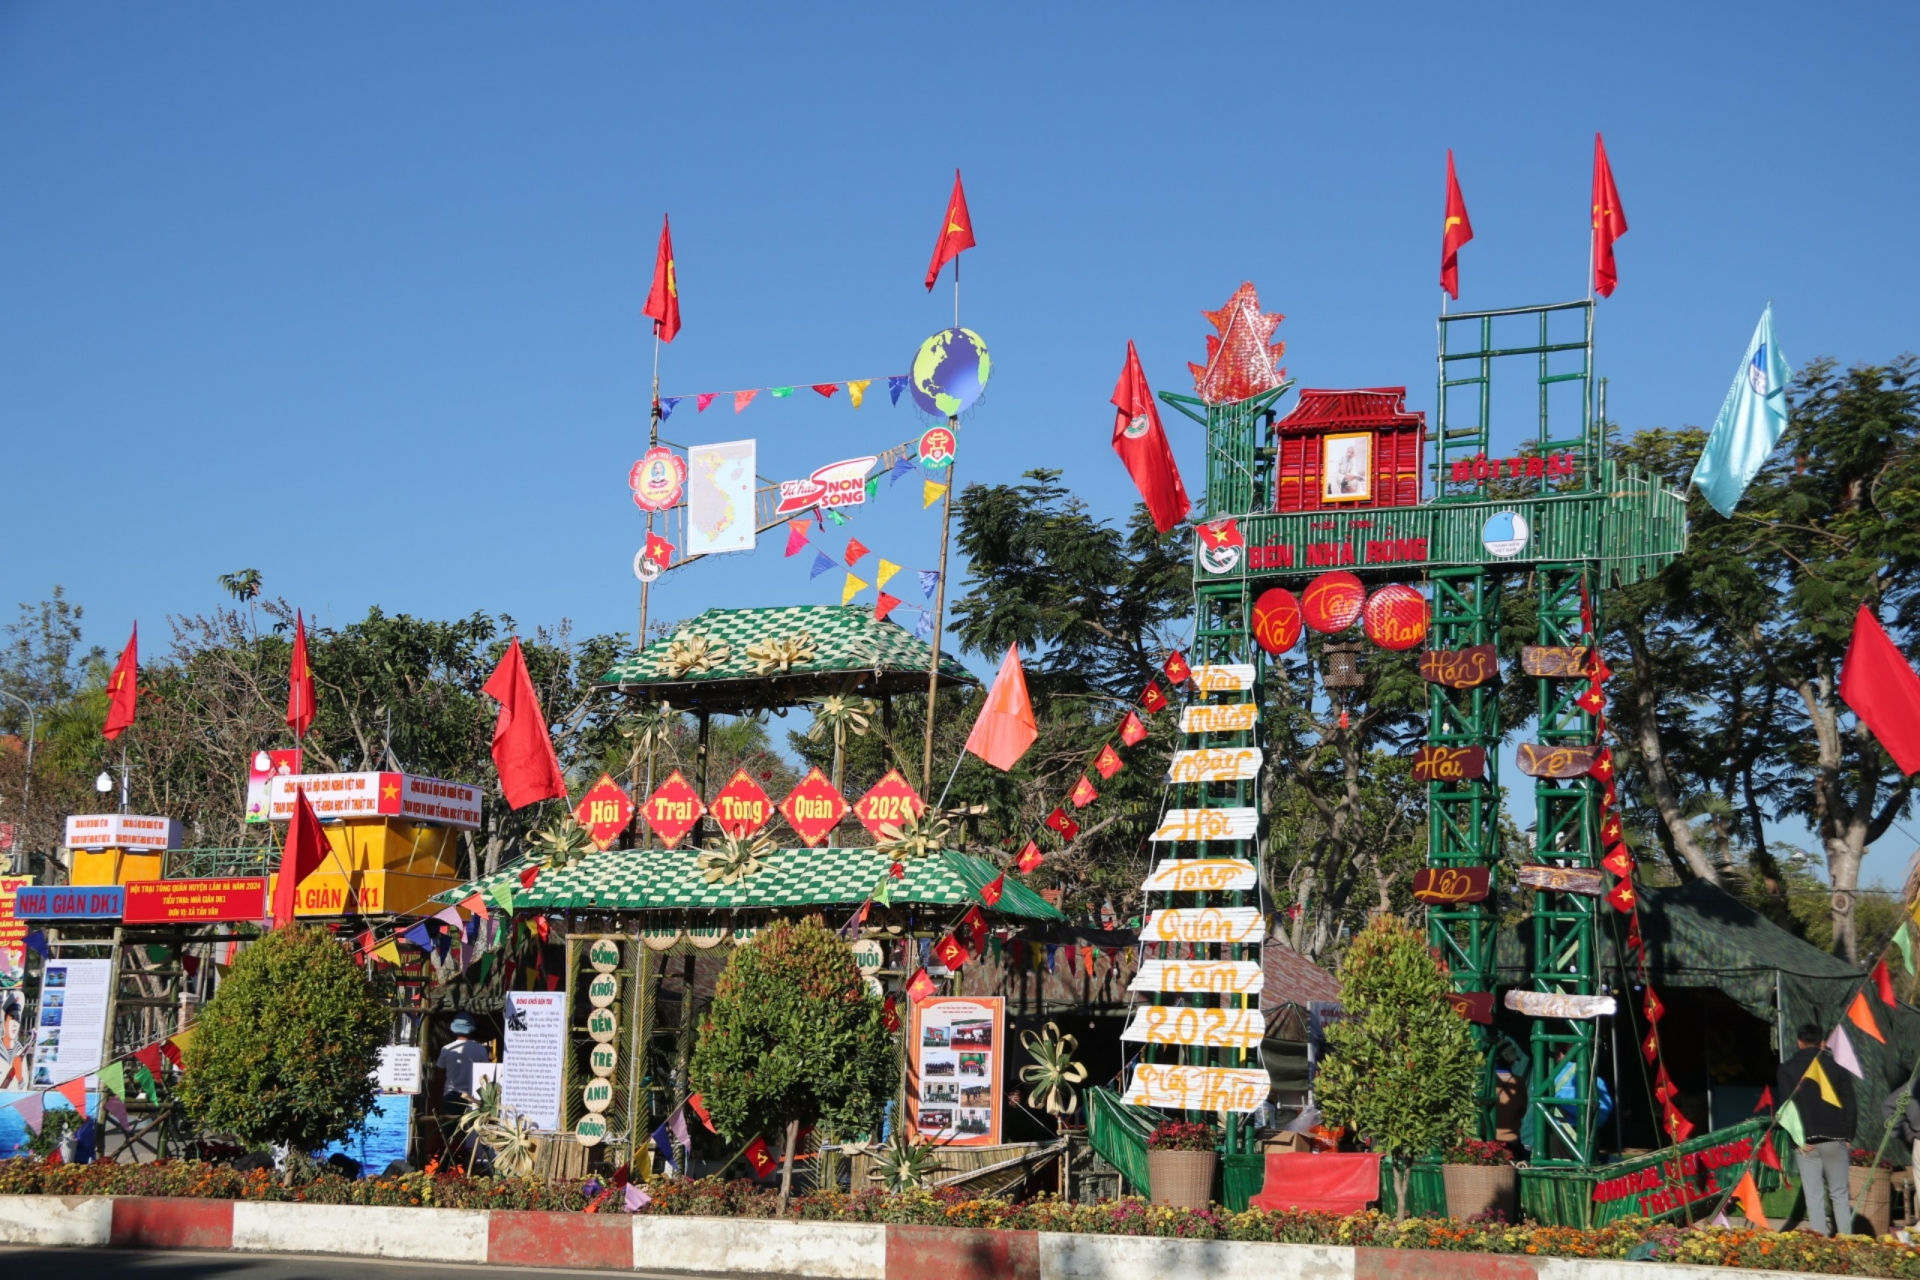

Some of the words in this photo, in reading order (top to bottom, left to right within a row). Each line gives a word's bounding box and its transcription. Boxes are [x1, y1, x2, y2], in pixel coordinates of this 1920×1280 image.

[1452, 451, 1501, 486] HỘI
[1507, 454, 1574, 481] TRẠI
[828, 478, 863, 491] NON
[821, 491, 864, 507] SÔNG
[1249, 533, 1294, 569] BẾN
[1306, 534, 1355, 566] NHÀ
[1366, 525, 1428, 563] RỒNG
[1254, 607, 1297, 648] Xã
[1305, 582, 1360, 620] Tân
[590, 800, 619, 828] Hội
[655, 797, 692, 825] Trại
[722, 796, 762, 824] Tòng
[795, 794, 833, 819] Quân
[869, 796, 911, 820] 2024
[209, 880, 221, 891] LÂM
[223, 880, 231, 891] HÀ
[232, 880, 245, 890] NĂM
[245, 882, 261, 890] 2024
[306, 883, 342, 908] GIÀN
[350, 887, 379, 908] DK1
[20, 889, 47, 914] NHÀ
[53, 889, 86, 914] GIÀN
[90, 894, 119, 914] DK1
[591, 1010, 612, 1033] BẾN
[1146, 1005, 1265, 1048] 2024
[593, 1052, 612, 1067] TRE
[586, 1085, 608, 1101] ANH
[578, 1117, 605, 1138] HÙNG
[1593, 1165, 1664, 1203] AMIRAL
